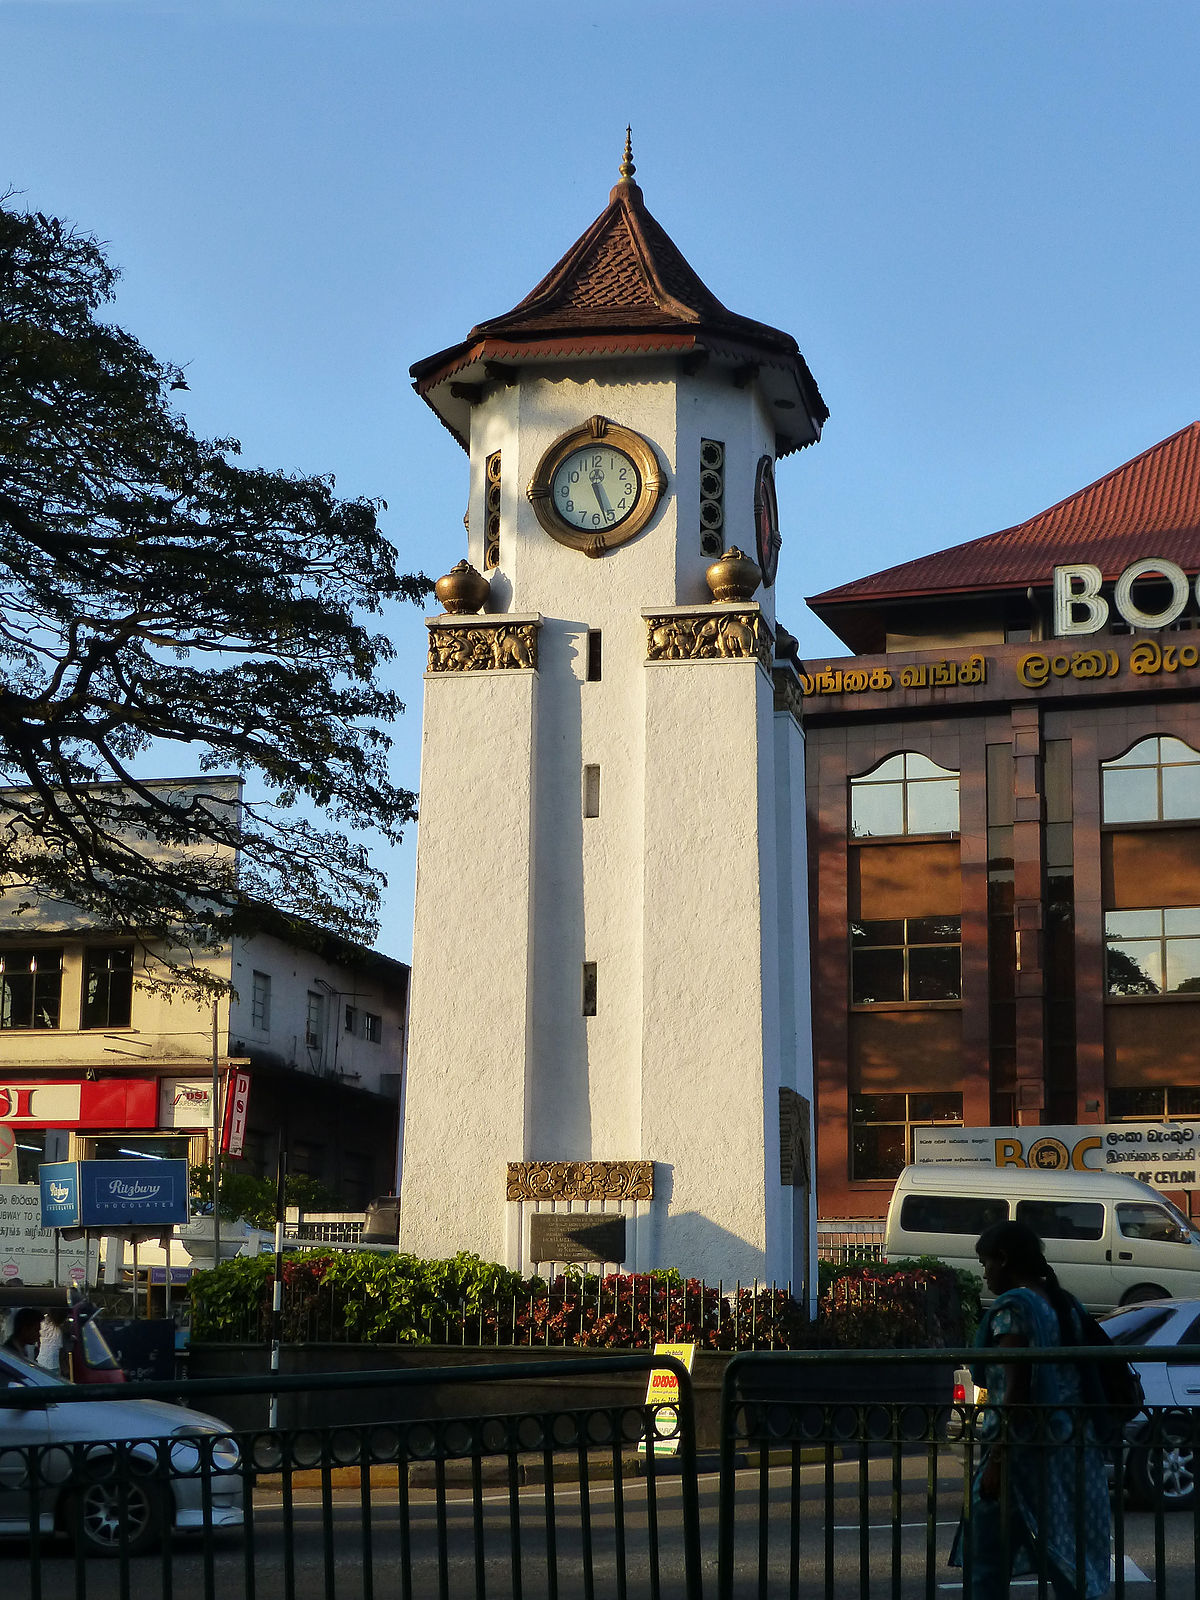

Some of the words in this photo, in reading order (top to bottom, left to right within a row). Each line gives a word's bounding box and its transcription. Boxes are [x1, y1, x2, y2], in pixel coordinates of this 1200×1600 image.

[580, 459, 588, 472] 11
[592, 455, 602, 468] 12
[568, 471, 580, 483] 10
[619, 468, 627, 480] 2
[561, 486, 570, 498] 9
[624, 483, 632, 495] 3
[566, 500, 574, 512] 8
[617, 498, 626, 510] 4
[578, 511, 588, 523] 7
[592, 514, 600, 526] 6
[606, 509, 616, 522] 5
[1054, 557, 1200, 636] BO
[900, 653, 986, 688] வங்கி
[1016, 649, 1120, 688] ලංකා
[186, 1090, 208, 1100] DSI
[235, 1079, 248, 1133] DSI
[1106, 1131, 1142, 1145] ලංකා
[1147, 1128, 1194, 1144] බැංකුව
[995, 1136, 1103, 1172] BOC
[1106, 1149, 1160, 1164] இலங்கை
[1162, 1148, 1195, 1161] வங்கி
[1138, 1171, 1152, 1183] OF
[1154, 1170, 1196, 1184] CEYLON
[109, 1179, 161, 1199] Ritzbury
[24, 1212, 33, 1220] TO
